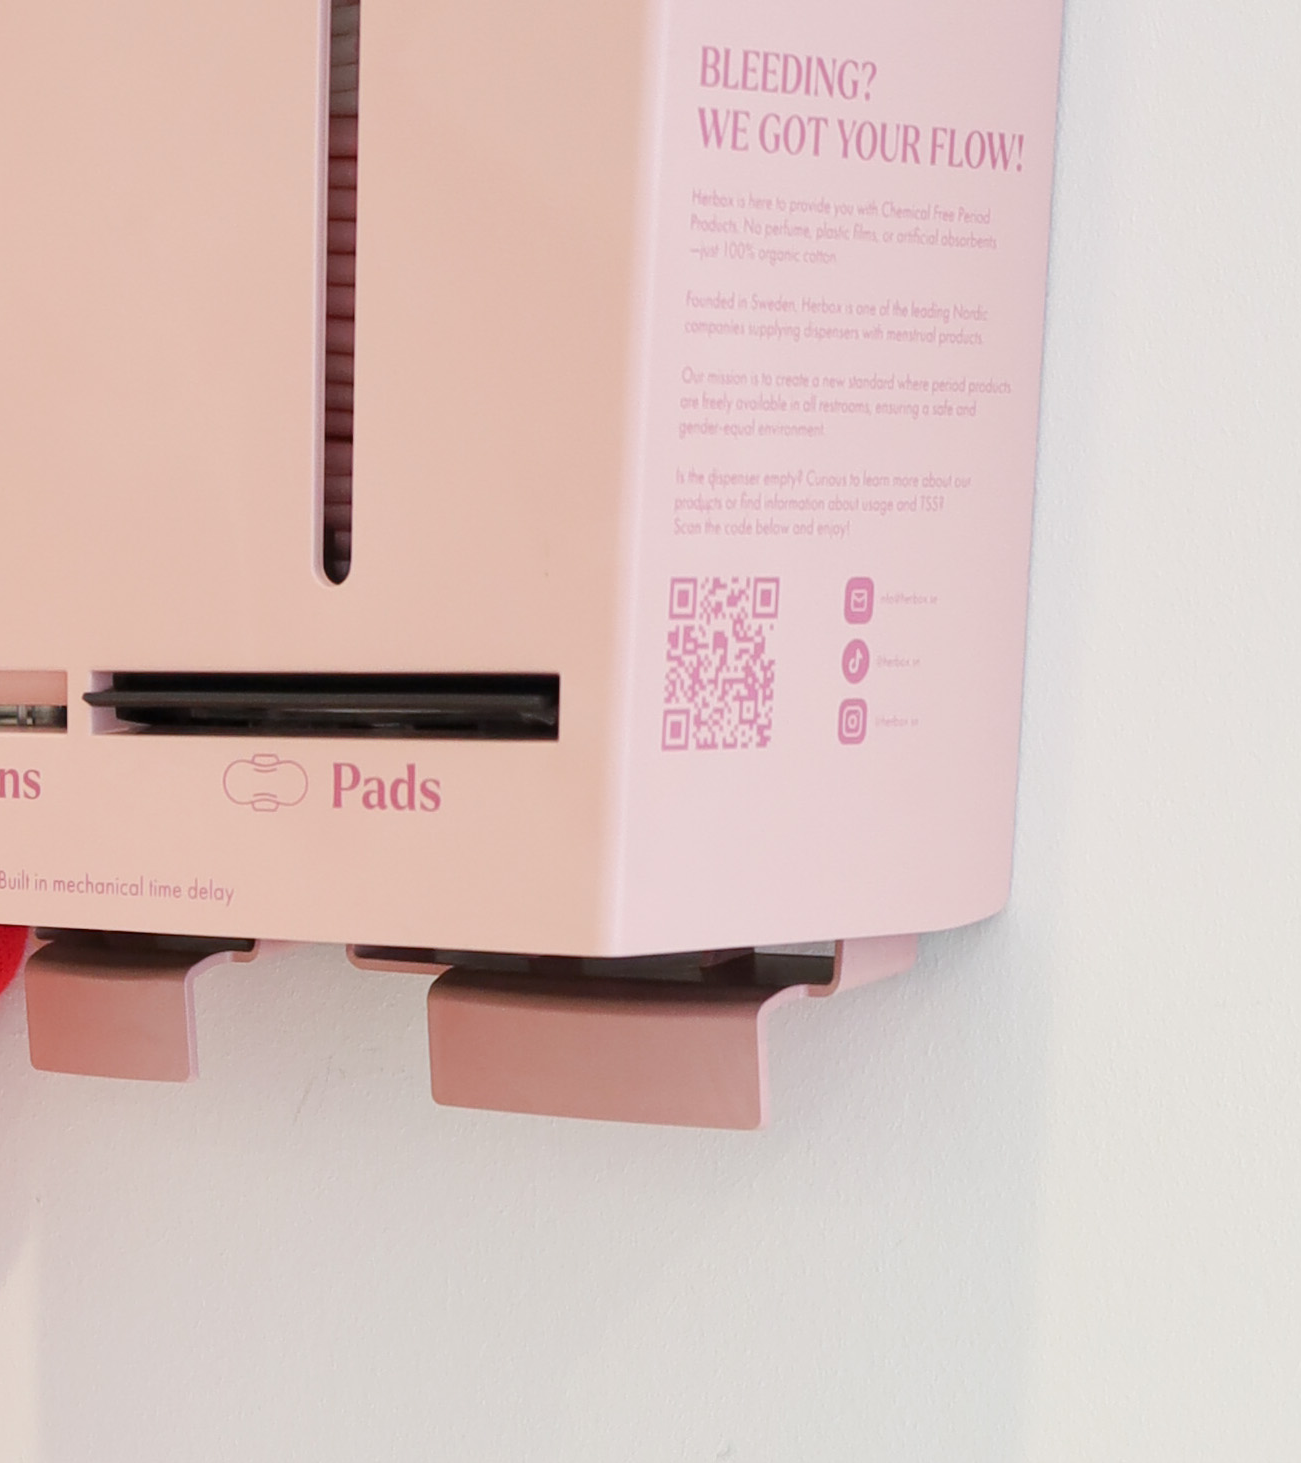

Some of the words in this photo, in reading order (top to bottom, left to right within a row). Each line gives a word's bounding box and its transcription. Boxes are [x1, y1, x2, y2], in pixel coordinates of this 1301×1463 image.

[700, 45, 878, 102] BLEEDING?
[698, 107, 750, 152] WE
[759, 112, 829, 157] GOT
[837, 118, 921, 165] YOUR
[930, 127, 1025, 172] FLOW!
[736, 195, 745, 208] is
[748, 193, 772, 210] here
[776, 198, 786, 211] to
[789, 197, 831, 214] provide
[834, 204, 854, 216] you
[857, 199, 878, 218] with
[882, 201, 930, 220] Chemical
[743, 218, 762, 235] No
[816, 223, 849, 240] plastic
[882, 232, 894, 243] or
[896, 227, 939, 245] artificial
[724, 242, 755, 259] 100%
[757, 249, 799, 266] organic
[737, 295, 748, 308] in
[802, 298, 841, 314] Herbox
[845, 301, 853, 314] is
[856, 305, 876, 316] one
[879, 299, 890, 316] of
[892, 300, 908, 317] the
[910, 301, 950, 324] leading
[863, 324, 883, 339] with
[886, 327, 936, 343] menstrual
[761, 373, 772, 386] to
[776, 374, 809, 387] create
[812, 377, 819, 388] a
[822, 377, 845, 388] new
[848, 373, 894, 390] standard
[897, 374, 928, 391] where
[932, 377, 966, 394] period
[968, 378, 1011, 396] products
[680, 397, 698, 409] are
[736, 394, 787, 411] available
[803, 395, 817, 412] all
[875, 403, 919, 420] ensuring
[922, 405, 929, 416] a
[932, 400, 953, 416] safe
[956, 400, 977, 417] and
[688, 468, 704, 484] the
[806, 469, 846, 486] Curious
[849, 474, 860, 487] to
[863, 470, 890, 487] learn
[893, 477, 918, 488] more
[922, 472, 952, 488] about
[725, 499, 736, 509] or
[740, 492, 761, 510] find
[764, 493, 825, 511] information
[828, 496, 859, 511] about
[862, 501, 893, 516] usage
[896, 496, 917, 512] and
[705, 519, 721, 534] the
[725, 518, 752, 535] code
[756, 518, 789, 535] below
[793, 519, 814, 535] and
[331, 762, 442, 813] Pads
[34, 873, 48, 891] in
[53, 873, 144, 897] mechanical
[149, 878, 182, 899] time
[187, 878, 235, 906] delay
